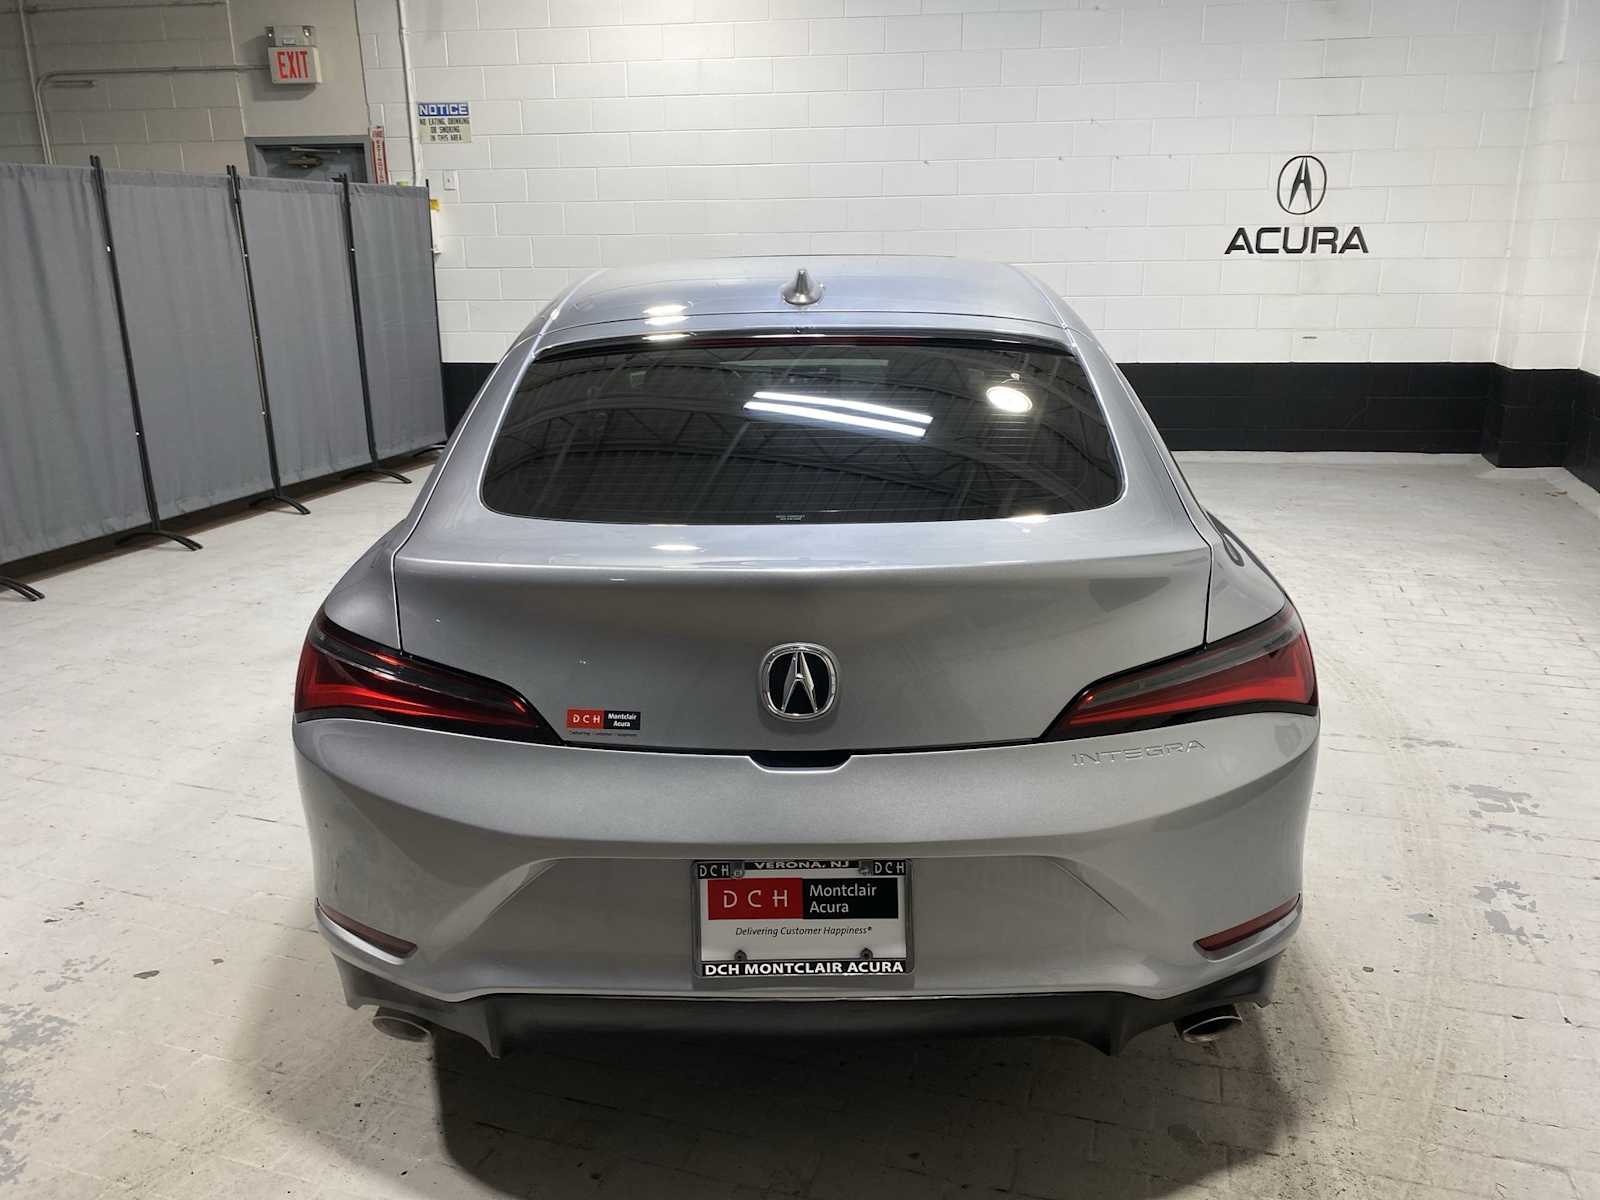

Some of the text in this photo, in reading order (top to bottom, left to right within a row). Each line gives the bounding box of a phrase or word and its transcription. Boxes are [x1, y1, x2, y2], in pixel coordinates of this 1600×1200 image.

[276, 50, 309, 79] EXIT
[419, 104, 468, 115] NOTICE
[1224, 226, 1369, 254] ACURA
[572, 714, 601, 723] DCH
[1071, 739, 1206, 767] INTEGRA
[699, 864, 729, 877] DCH
[830, 860, 849, 868] NJ
[874, 861, 905, 874] DCH
[723, 883, 877, 908] DCH Montclair
[809, 901, 849, 913] Acura
[735, 927, 779, 937] Delivering
[780, 927, 821, 936] Customer
[704, 961, 904, 976] DCH MONTCLAIR ACURA
